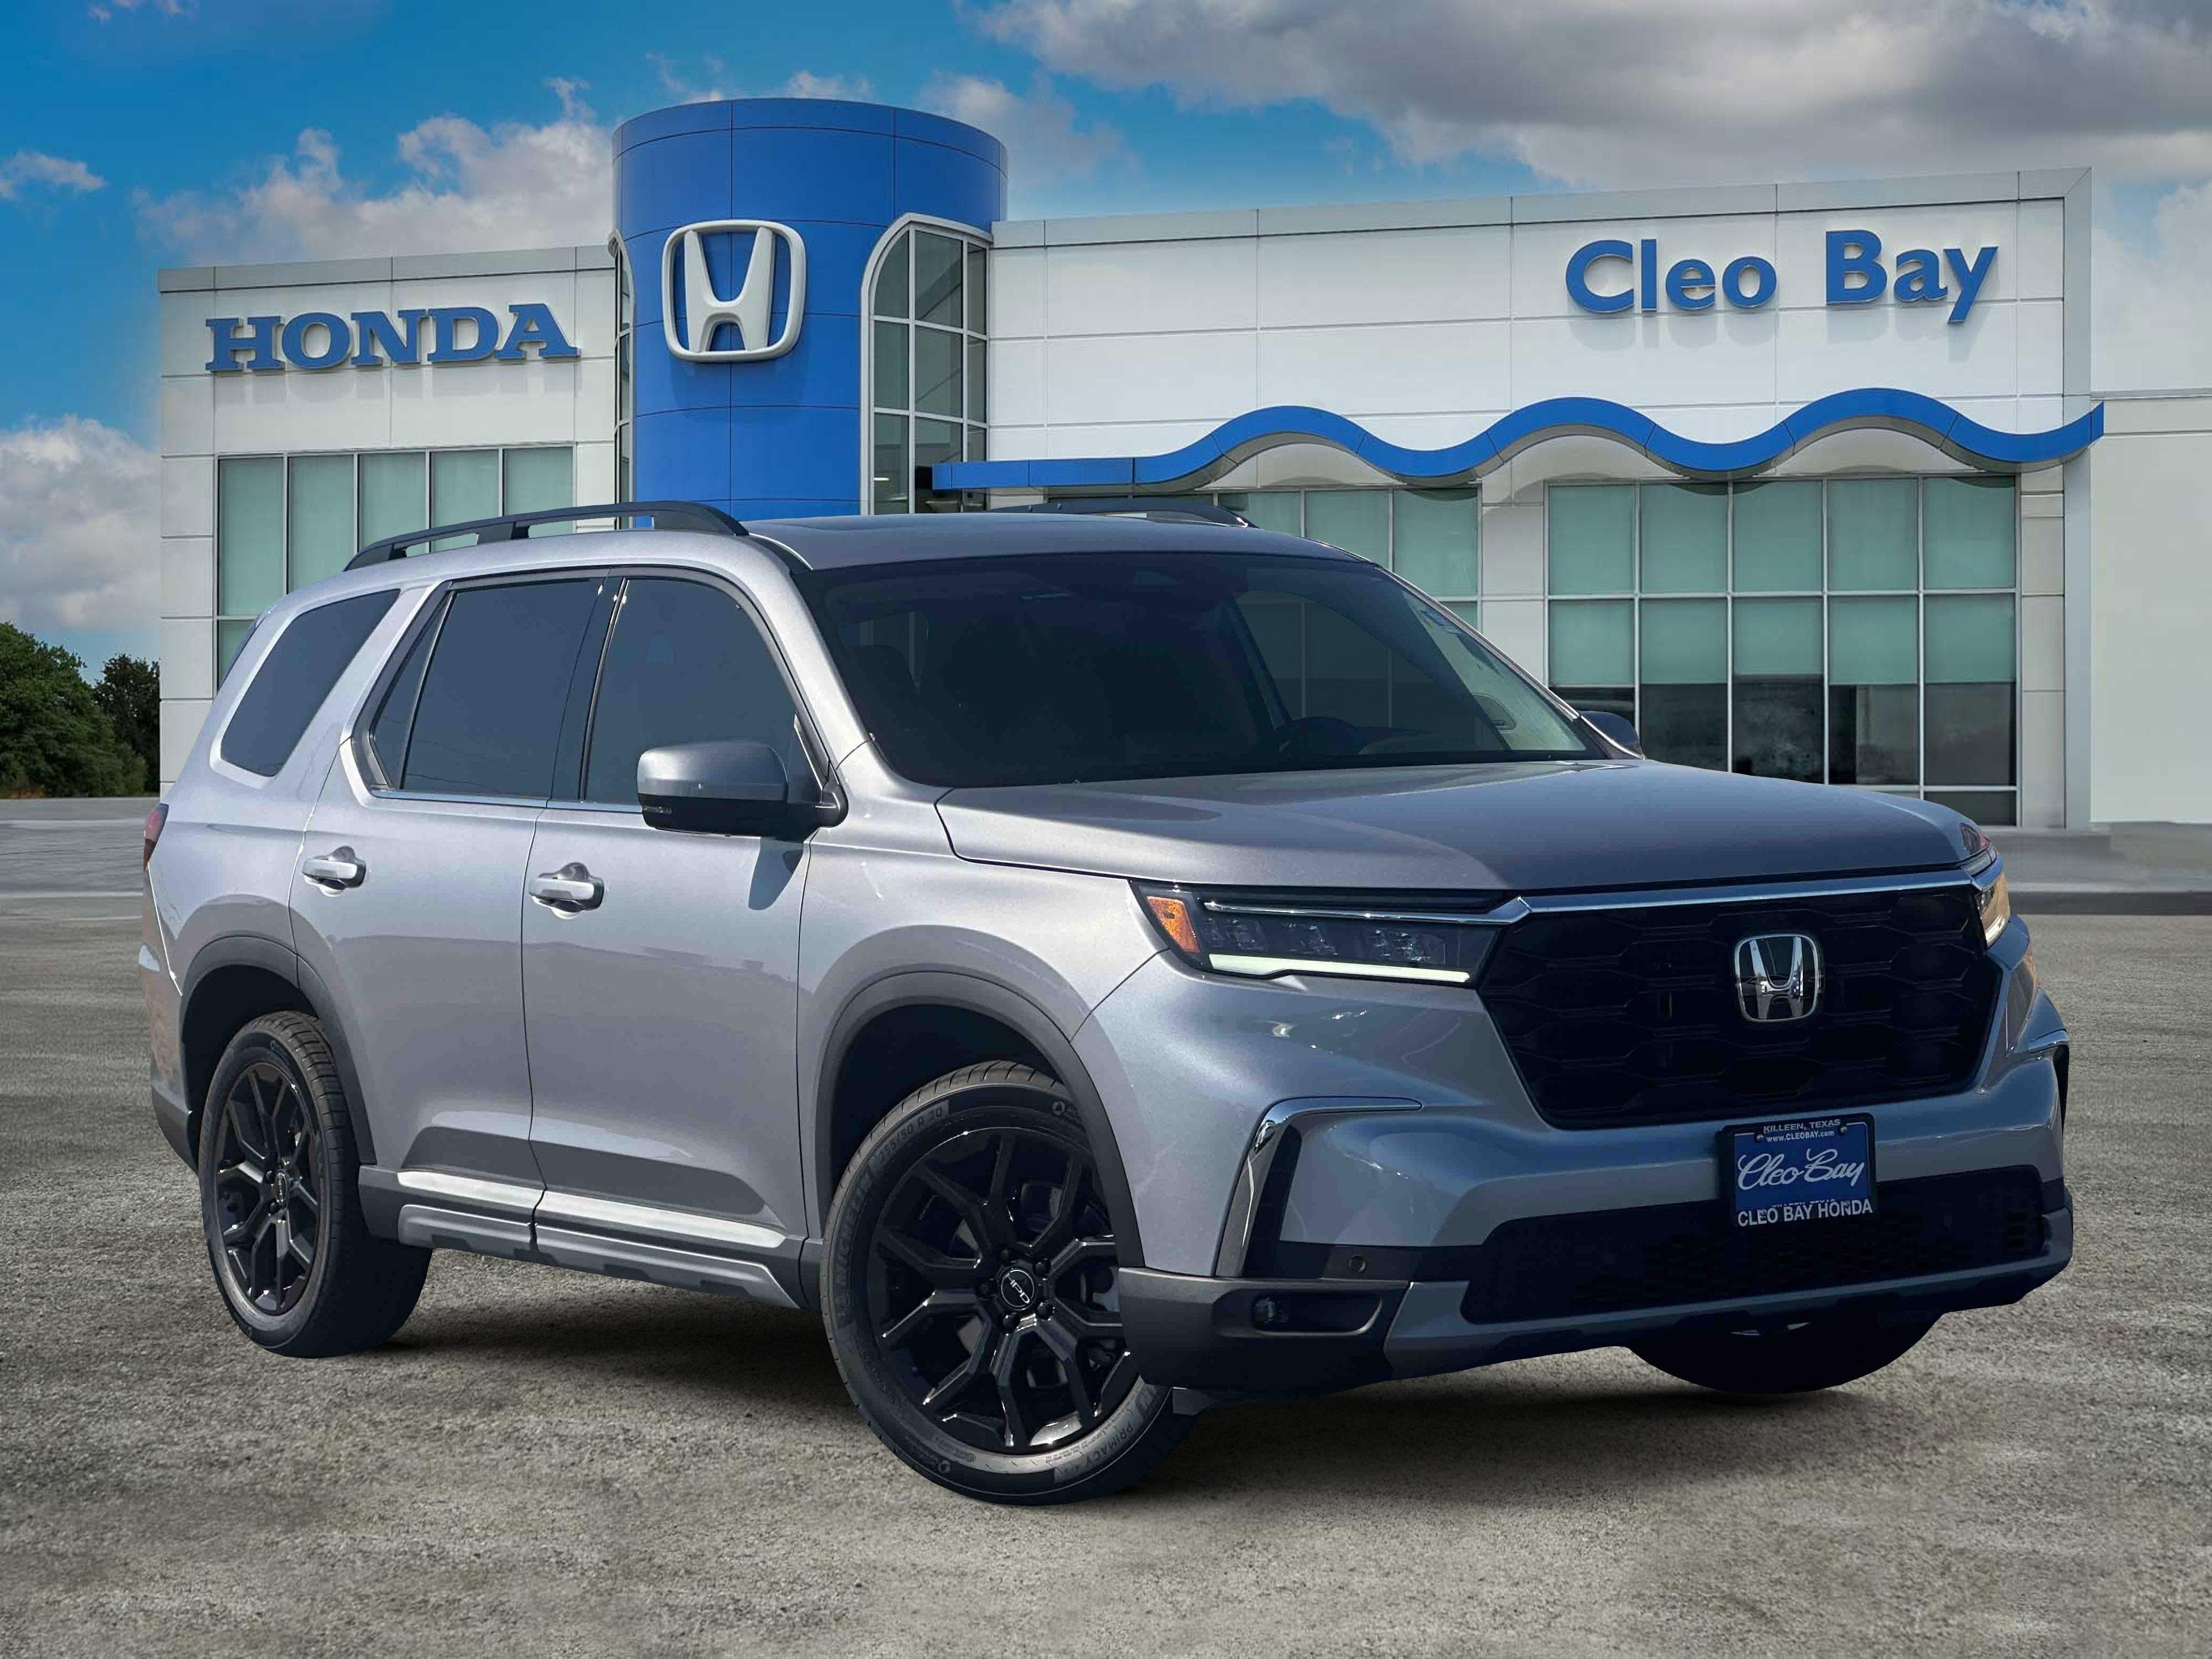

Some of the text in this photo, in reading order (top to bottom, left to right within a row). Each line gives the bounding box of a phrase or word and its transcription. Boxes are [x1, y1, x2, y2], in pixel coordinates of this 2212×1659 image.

[1565, 229, 1999, 324] Cleo Bay
[205, 303, 582, 373] HONDA
[1763, 1119, 1841, 1133] KILLEEN, TEXAS
[1765, 1130, 1835, 1143] www.CLEOBAY.com
[1737, 1148, 1865, 1190] Cleo Bay
[1737, 1207, 1779, 1227] CLEO
[1783, 1204, 1813, 1222] BAY
[1818, 1198, 1874, 1218] HONDA
[1005, 1272, 1031, 1304] HPD
